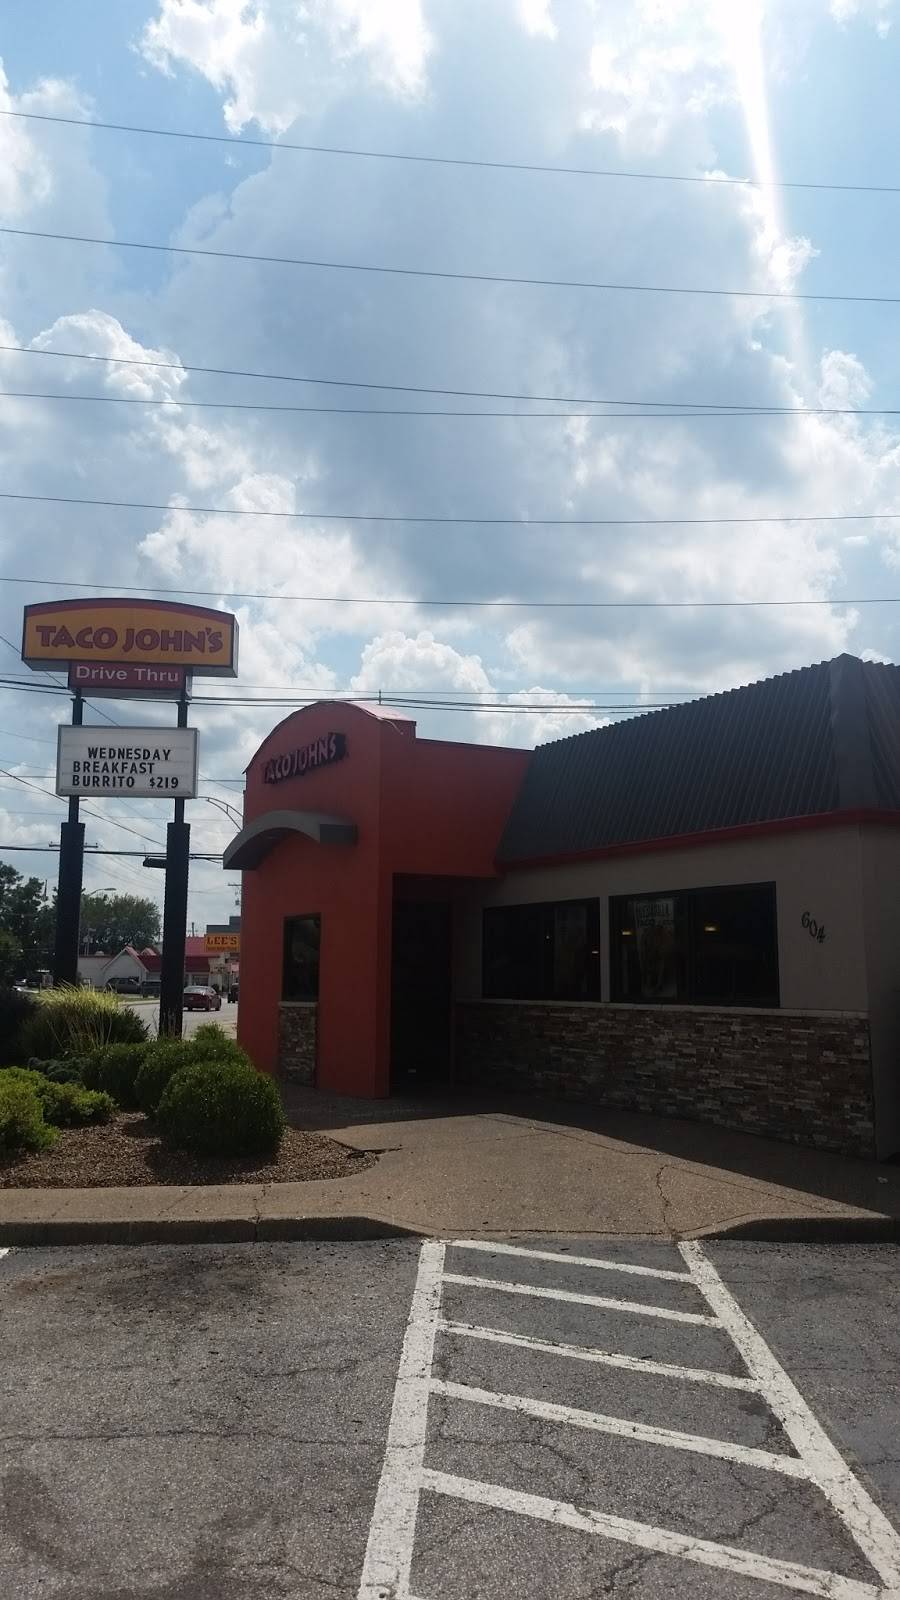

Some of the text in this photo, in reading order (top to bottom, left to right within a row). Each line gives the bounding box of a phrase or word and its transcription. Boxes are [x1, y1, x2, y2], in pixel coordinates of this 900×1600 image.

[35, 625, 224, 653] TACO JOHN'S
[76, 665, 179, 683] Drive Thru
[87, 747, 172, 761] WEDNESDAY
[73, 761, 155, 774] BREAKFAST
[72, 775, 179, 789] BURRITO $219
[802, 911, 826, 944] 604
[207, 936, 237, 945] LEE'S
